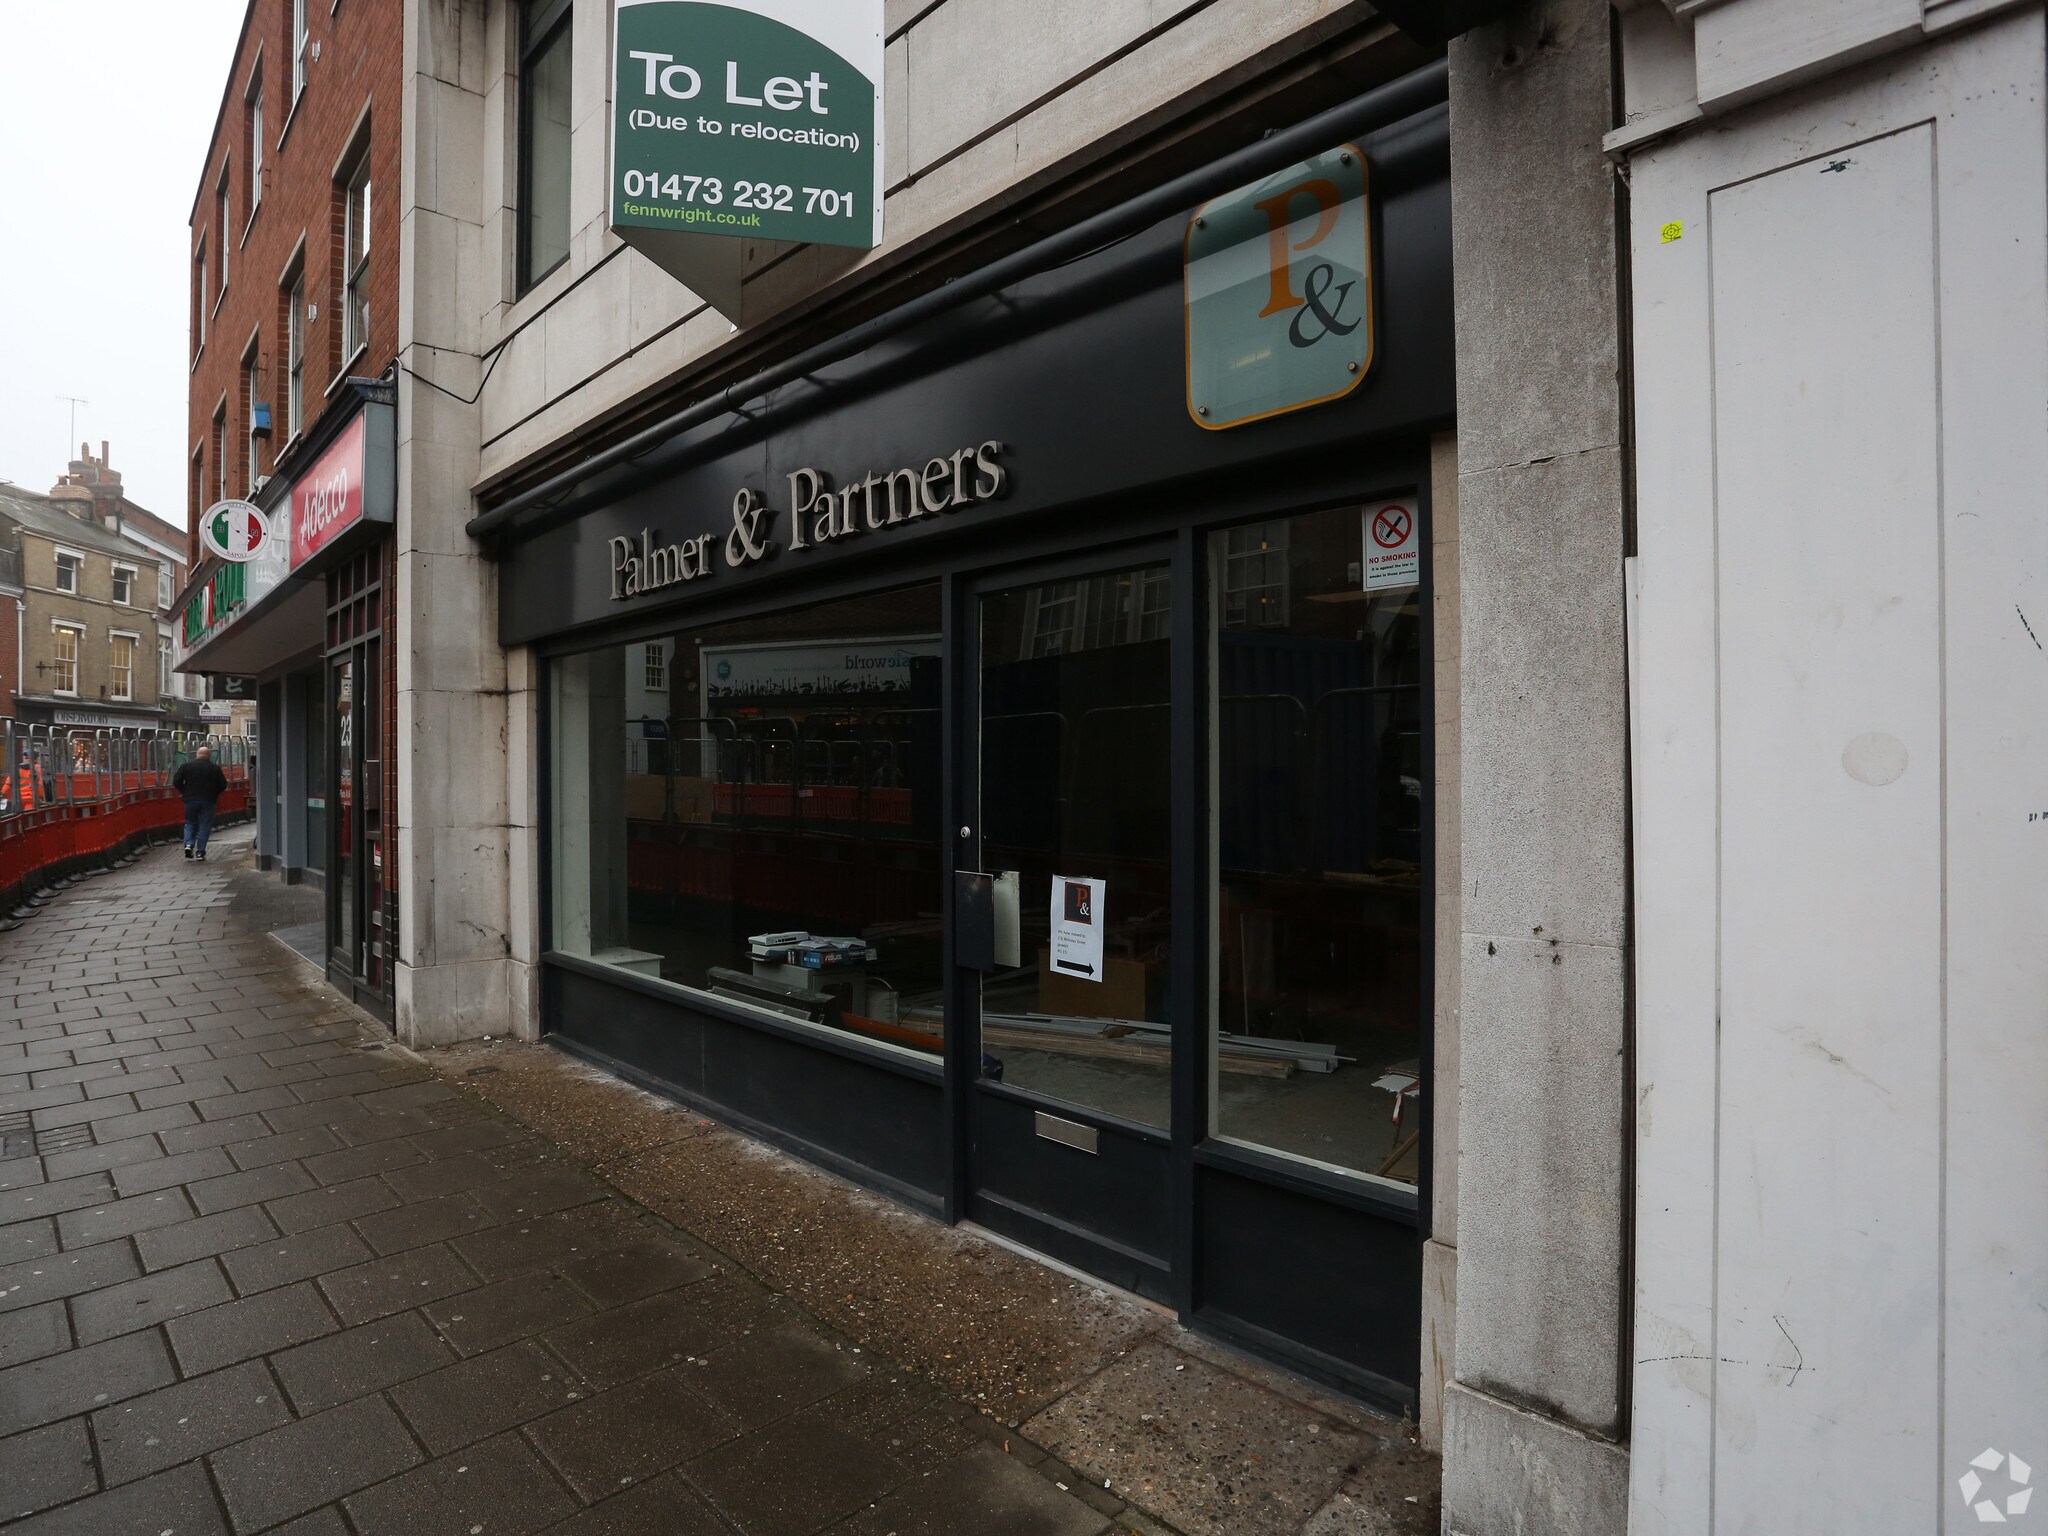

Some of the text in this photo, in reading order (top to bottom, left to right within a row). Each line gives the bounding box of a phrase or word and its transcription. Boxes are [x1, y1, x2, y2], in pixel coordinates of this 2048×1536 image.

[629, 50, 828, 115] To Let
[629, 109, 860, 152] (Due to relocation)
[623, 170, 853, 217] 01473 232 701
[623, 202, 761, 227] fennwright.co.uk
[301, 467, 347, 546] Adecco
[608, 440, 1006, 600] Palmer & Partners
[1369, 552, 1416, 564] NO SMOKING
[56, 711, 108, 724] OBSERVATORY
